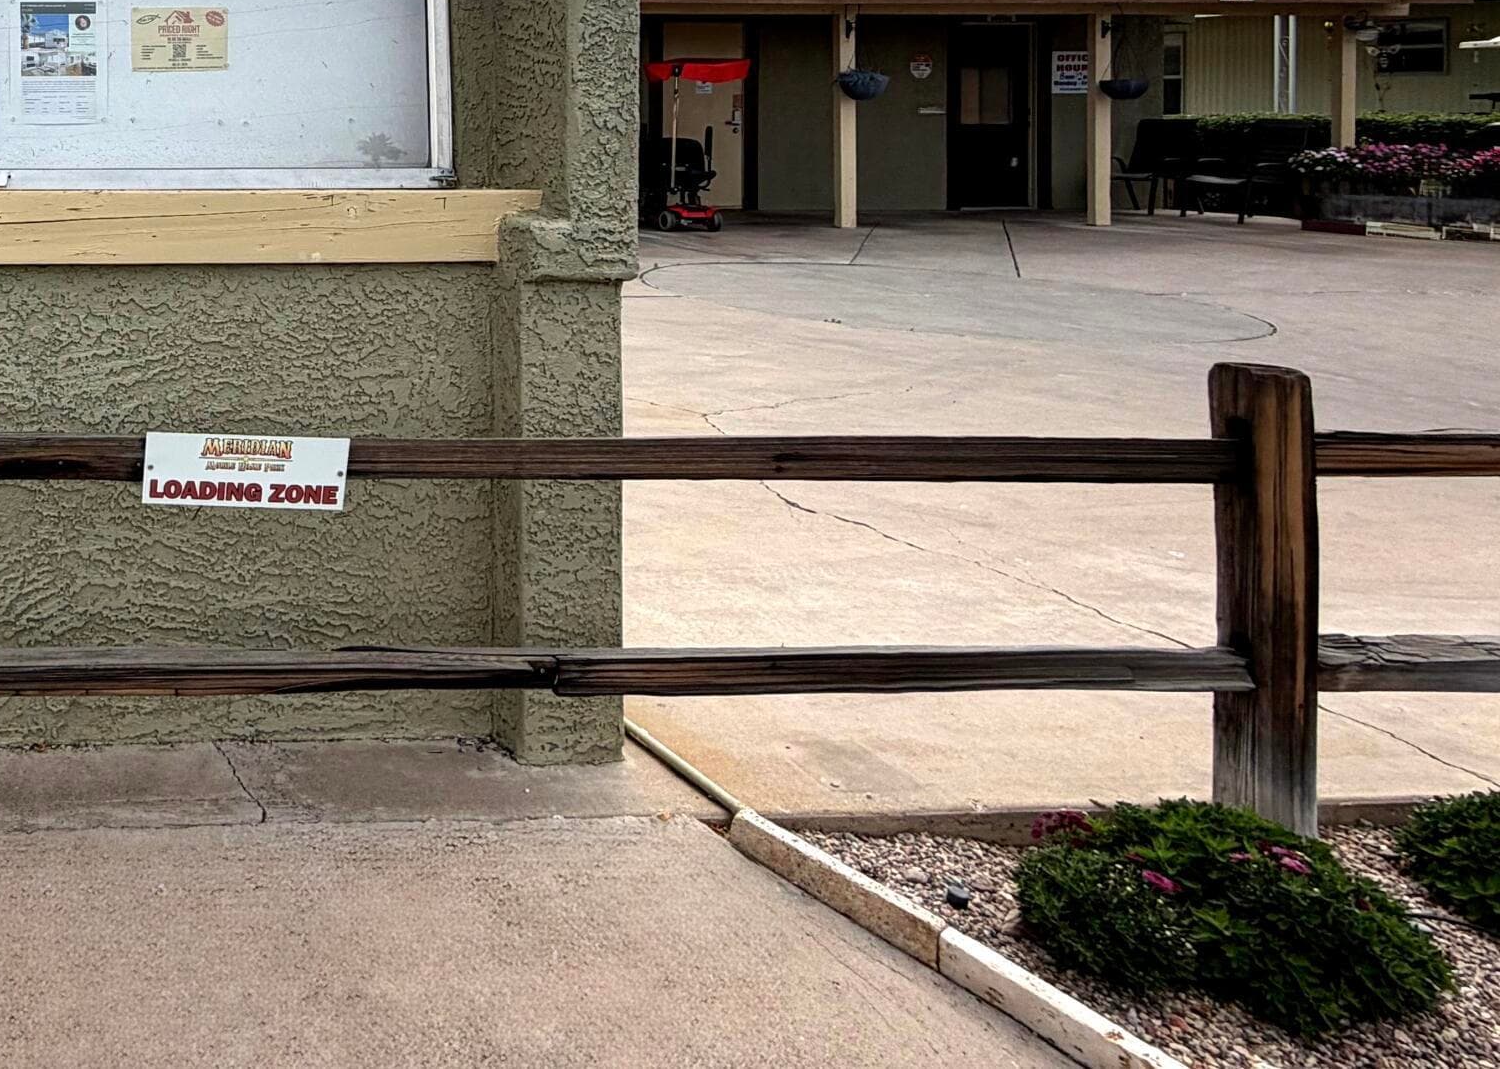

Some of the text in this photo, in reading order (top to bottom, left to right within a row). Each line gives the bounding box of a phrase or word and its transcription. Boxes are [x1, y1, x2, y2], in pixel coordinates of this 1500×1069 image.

[157, 24, 200, 34] PRICED RIGHT
[1057, 54, 1088, 62] OFFIC
[1056, 64, 1088, 72] HOUR
[201, 437, 293, 460] MERIDIAN
[149, 479, 339, 505] LOADING ZONE
